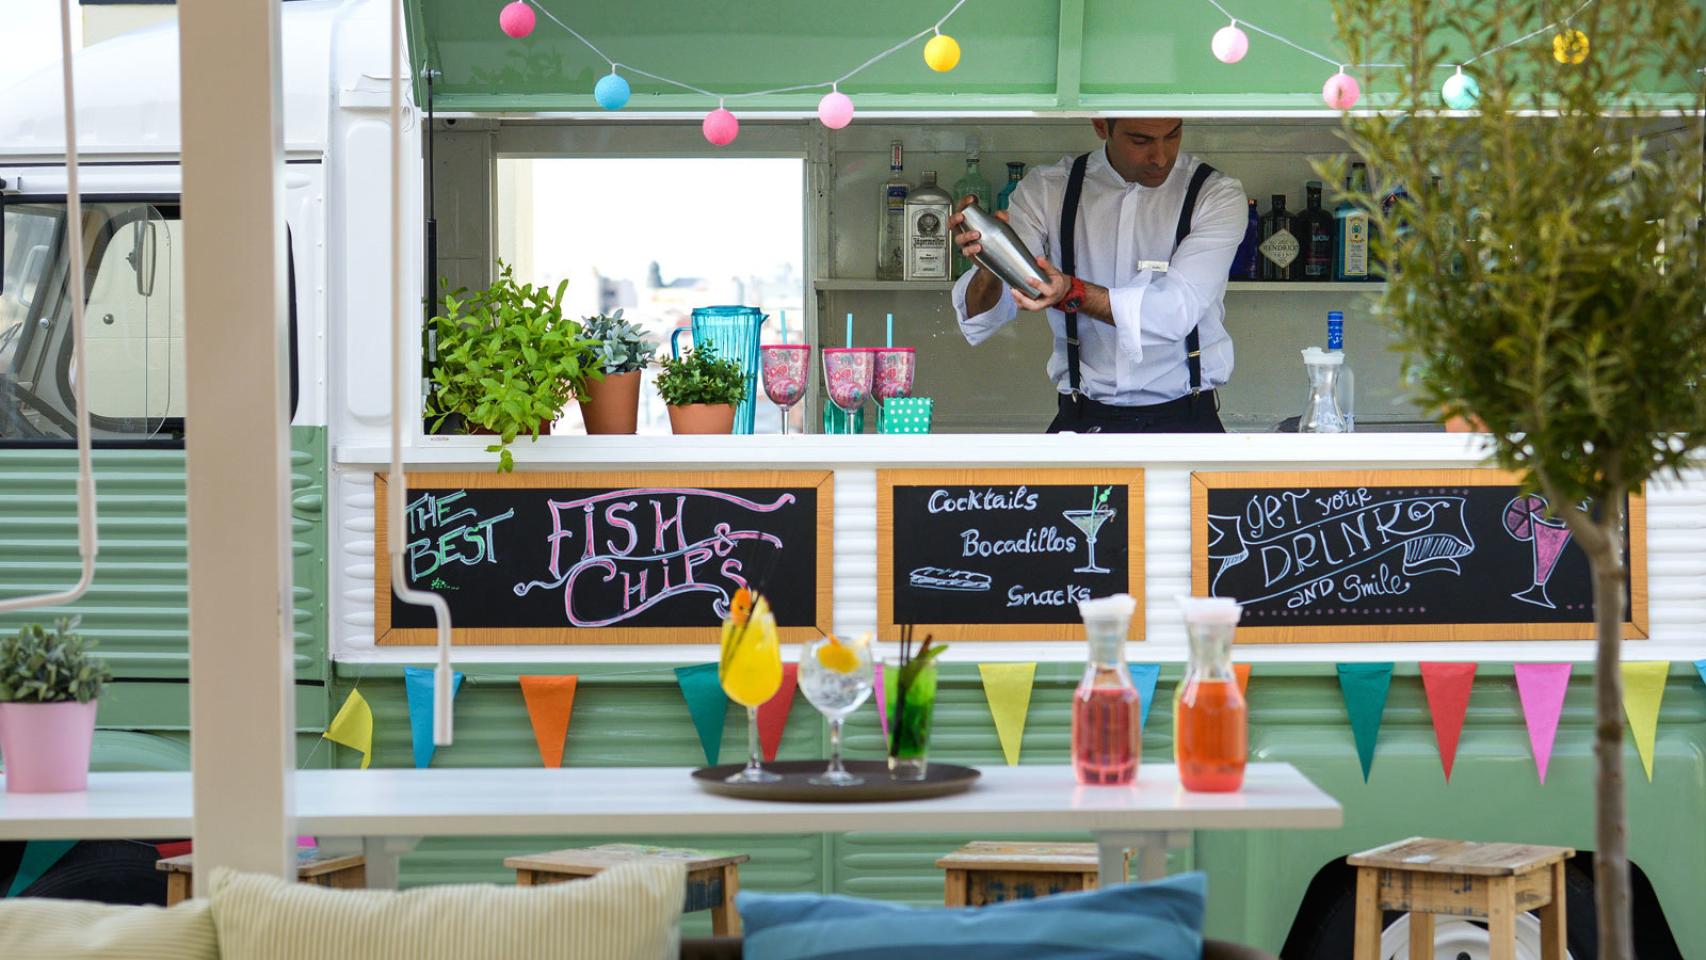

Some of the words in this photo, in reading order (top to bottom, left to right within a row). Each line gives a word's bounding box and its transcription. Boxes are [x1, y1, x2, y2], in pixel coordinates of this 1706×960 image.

[404, 489, 477, 534] THE
[927, 485, 1039, 514] Cocktails
[406, 508, 514, 582] BEST
[714, 522, 739, 557] &
[960, 526, 1077, 557] Bocadillos
